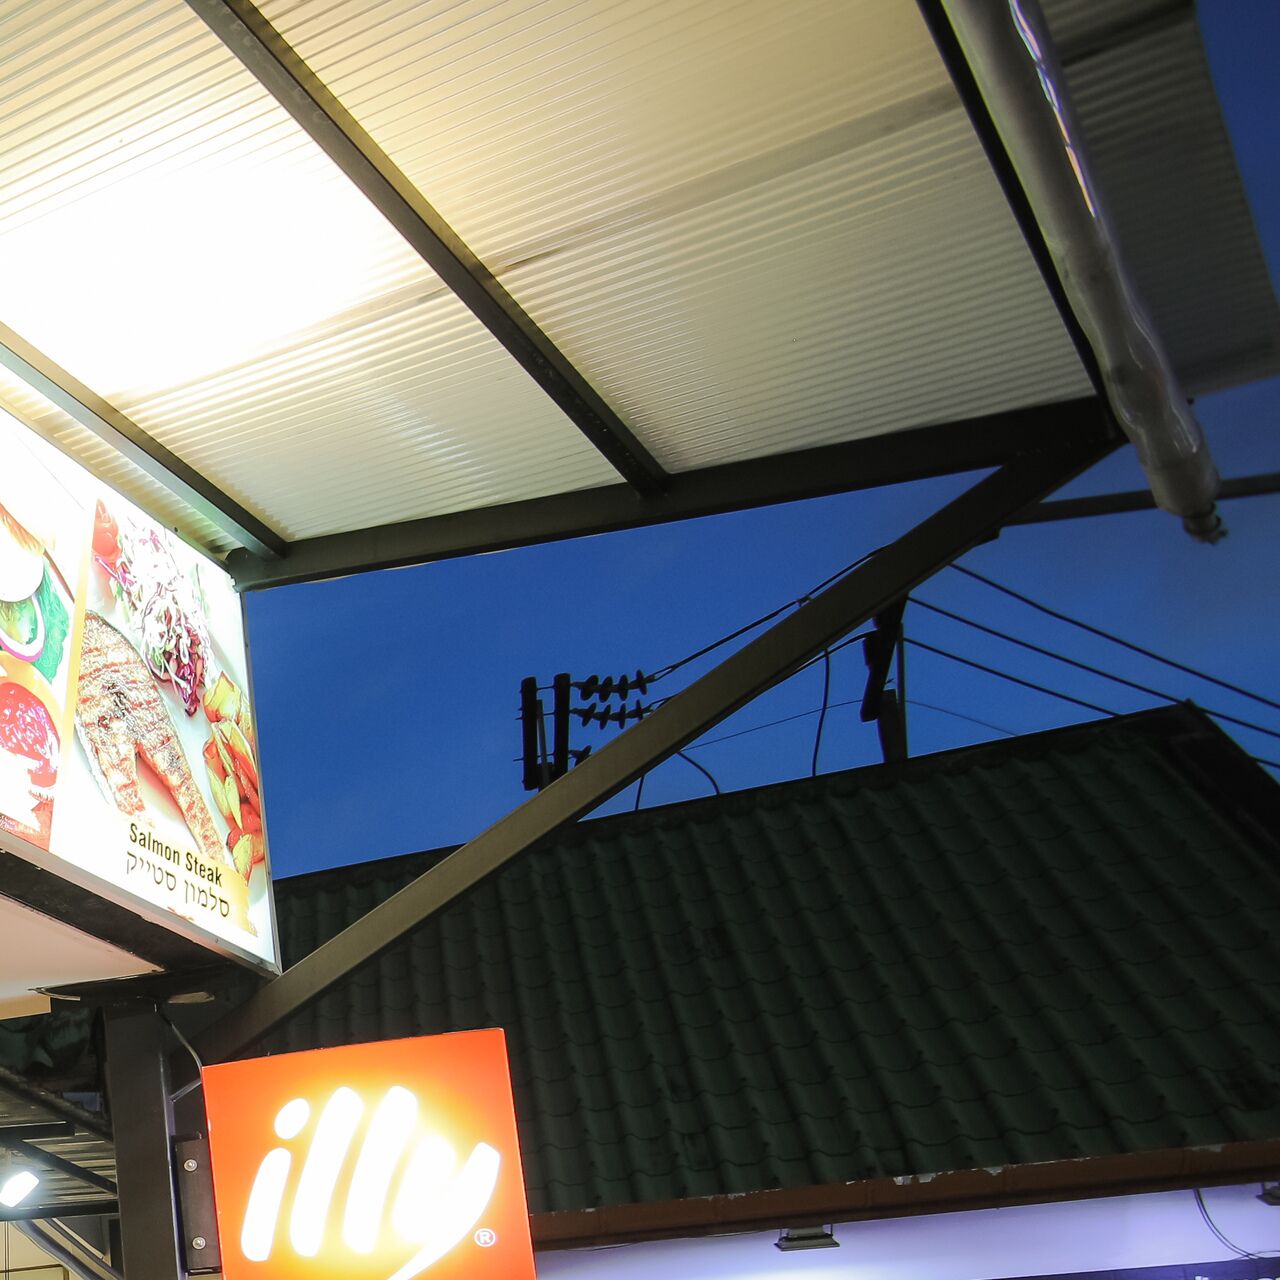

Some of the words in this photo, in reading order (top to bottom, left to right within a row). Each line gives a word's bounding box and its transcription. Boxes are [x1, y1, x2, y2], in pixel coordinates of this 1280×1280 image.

[126, 851, 177, 891] סטייק
[129, 823, 180, 866] Salmon
[185, 852, 223, 887] Steak
[184, 880, 230, 917] סלמון
